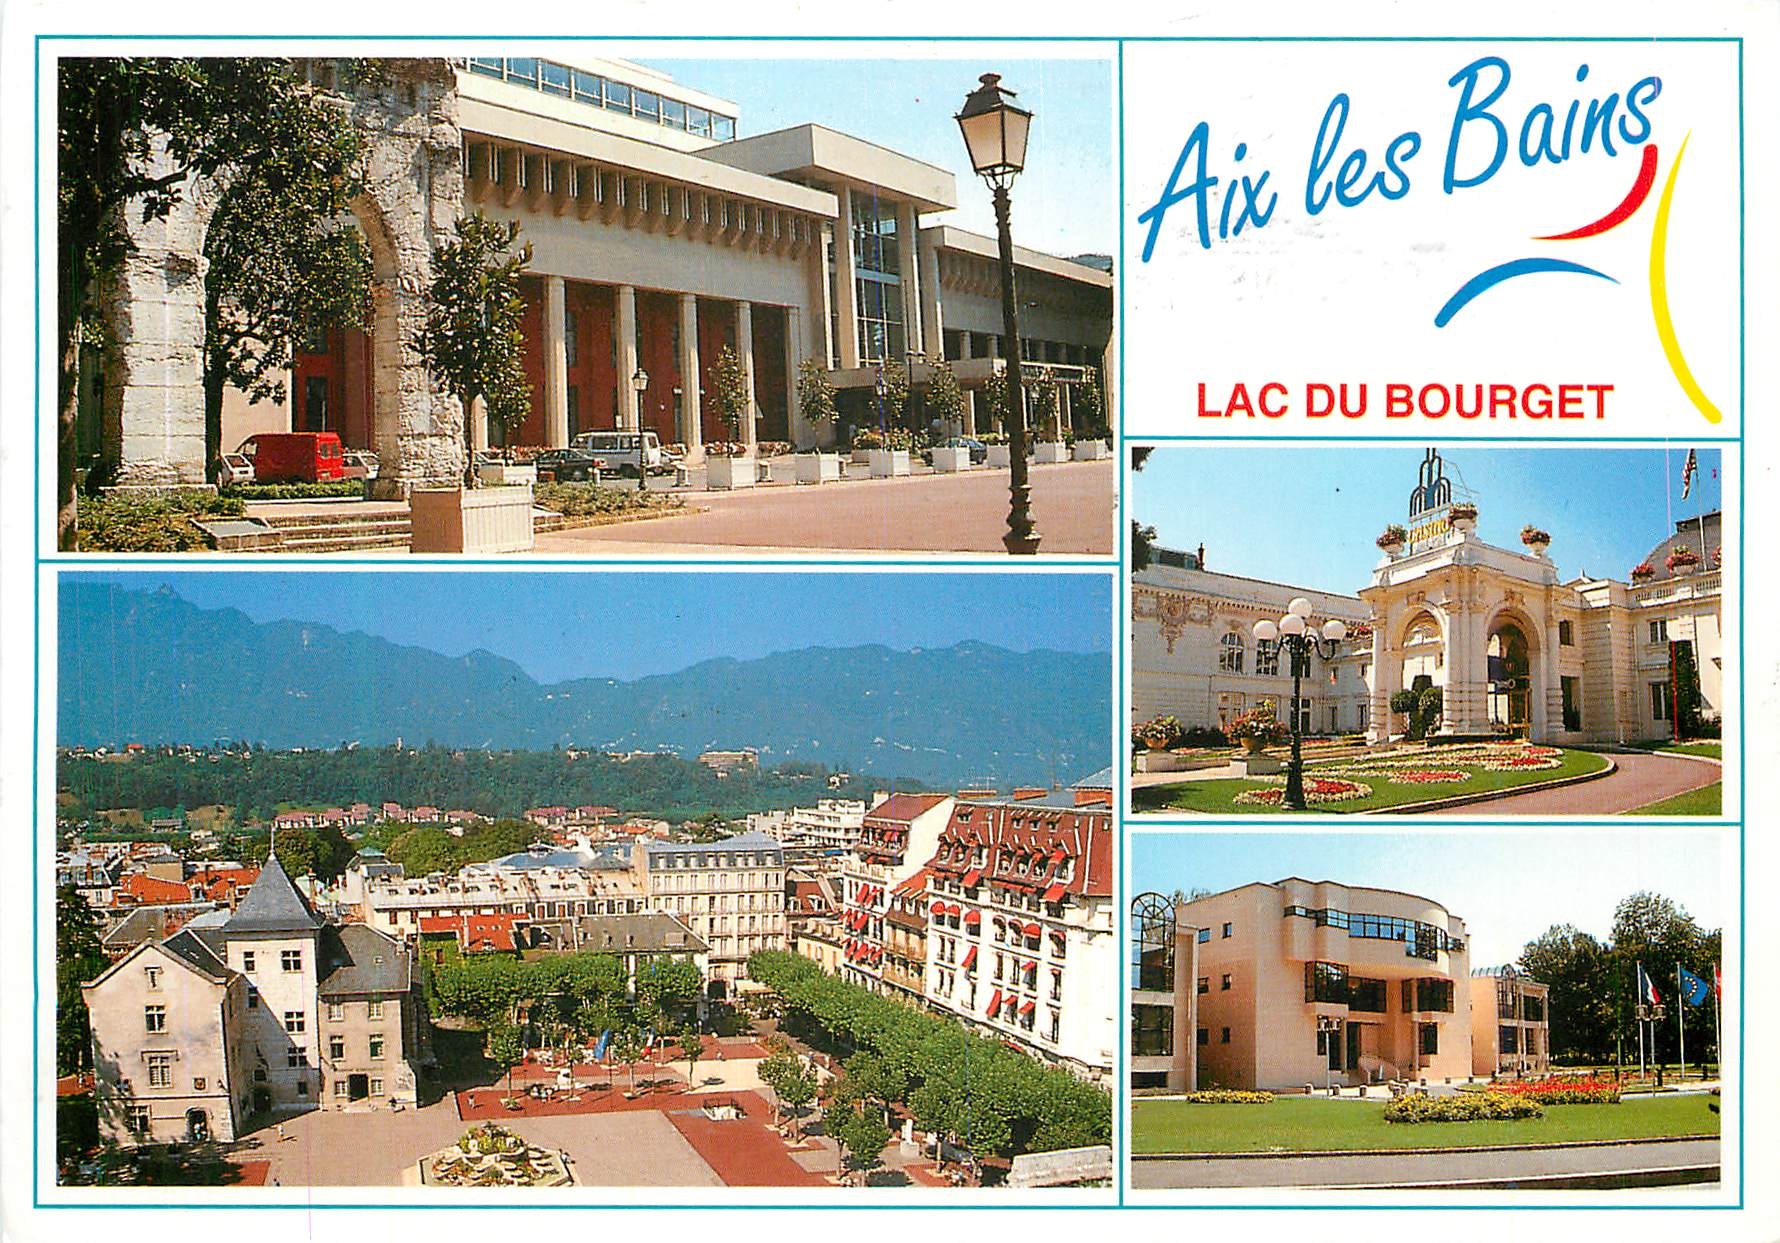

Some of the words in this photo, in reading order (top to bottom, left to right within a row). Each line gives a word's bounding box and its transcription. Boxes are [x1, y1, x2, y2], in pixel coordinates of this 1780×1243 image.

[1137, 122, 1278, 264] Aix
[1305, 93, 1422, 216] les
[1443, 56, 1662, 195] Bains
[1198, 382, 1288, 419] LAC
[1306, 382, 1367, 419] DU
[1386, 382, 1614, 420] BOURGET
